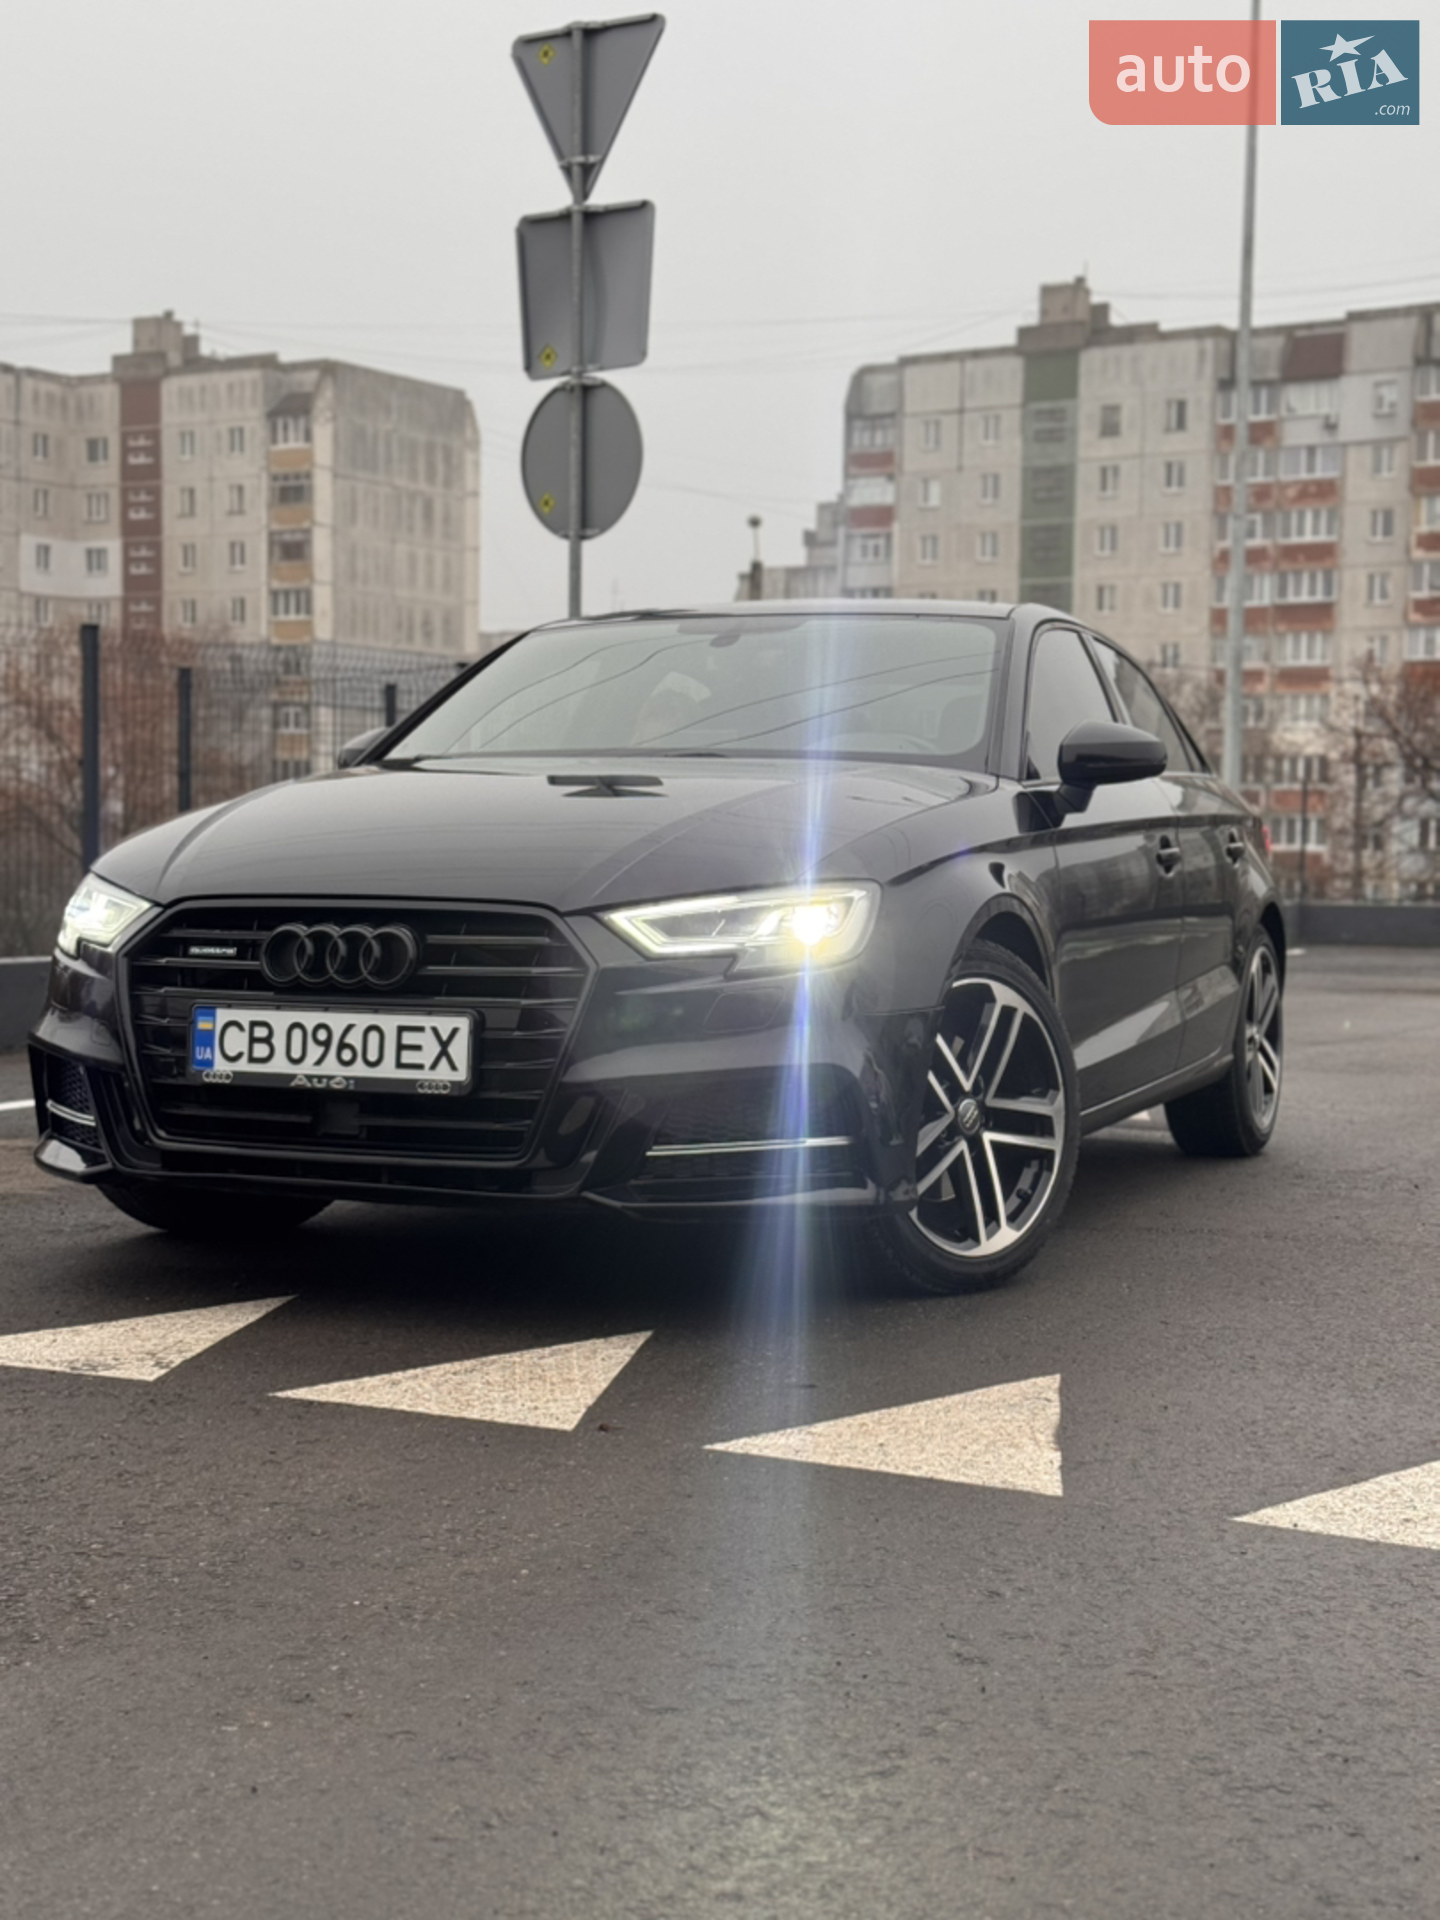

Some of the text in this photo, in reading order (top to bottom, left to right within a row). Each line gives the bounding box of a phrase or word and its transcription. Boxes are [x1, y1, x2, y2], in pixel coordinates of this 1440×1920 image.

[195, 1046, 212, 1060] UA
[218, 1020, 461, 1072] CB 0960 EX
